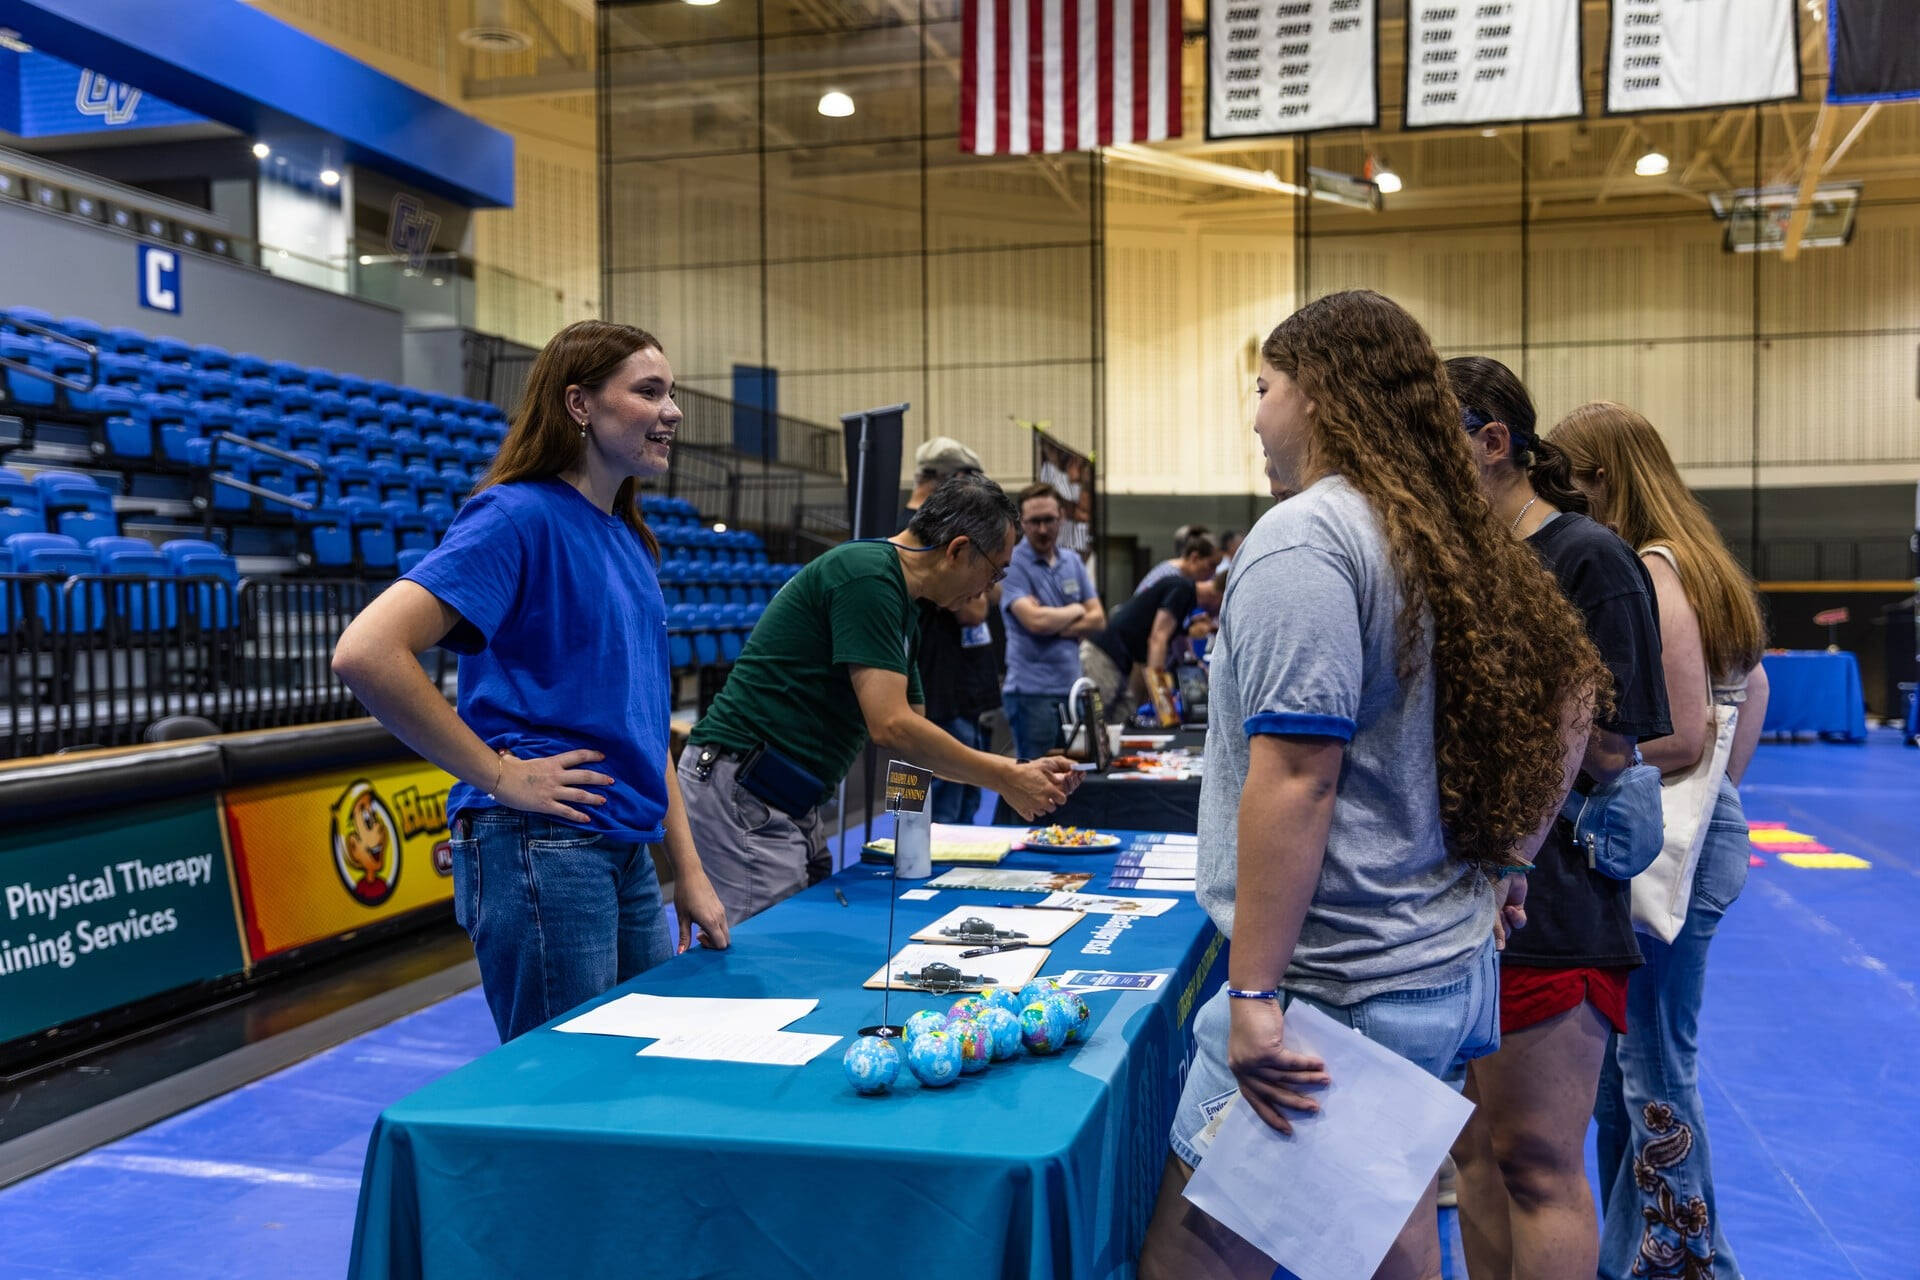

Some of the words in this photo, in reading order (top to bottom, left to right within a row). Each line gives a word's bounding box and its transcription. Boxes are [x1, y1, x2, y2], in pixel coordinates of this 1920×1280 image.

[1226, 7, 1260, 22] 2000
[1421, 8, 1456, 22] 2000
[1328, 17, 1360, 33] 2024
[1422, 29, 1452, 44] 2001
[1226, 87, 1260, 101] 2004
[1278, 103, 1310, 118] 2014
[147, 249, 175, 310] C
[6, 865, 116, 920] Physical
[116, 853, 213, 888] Therapy
[76, 907, 178, 954] Services
